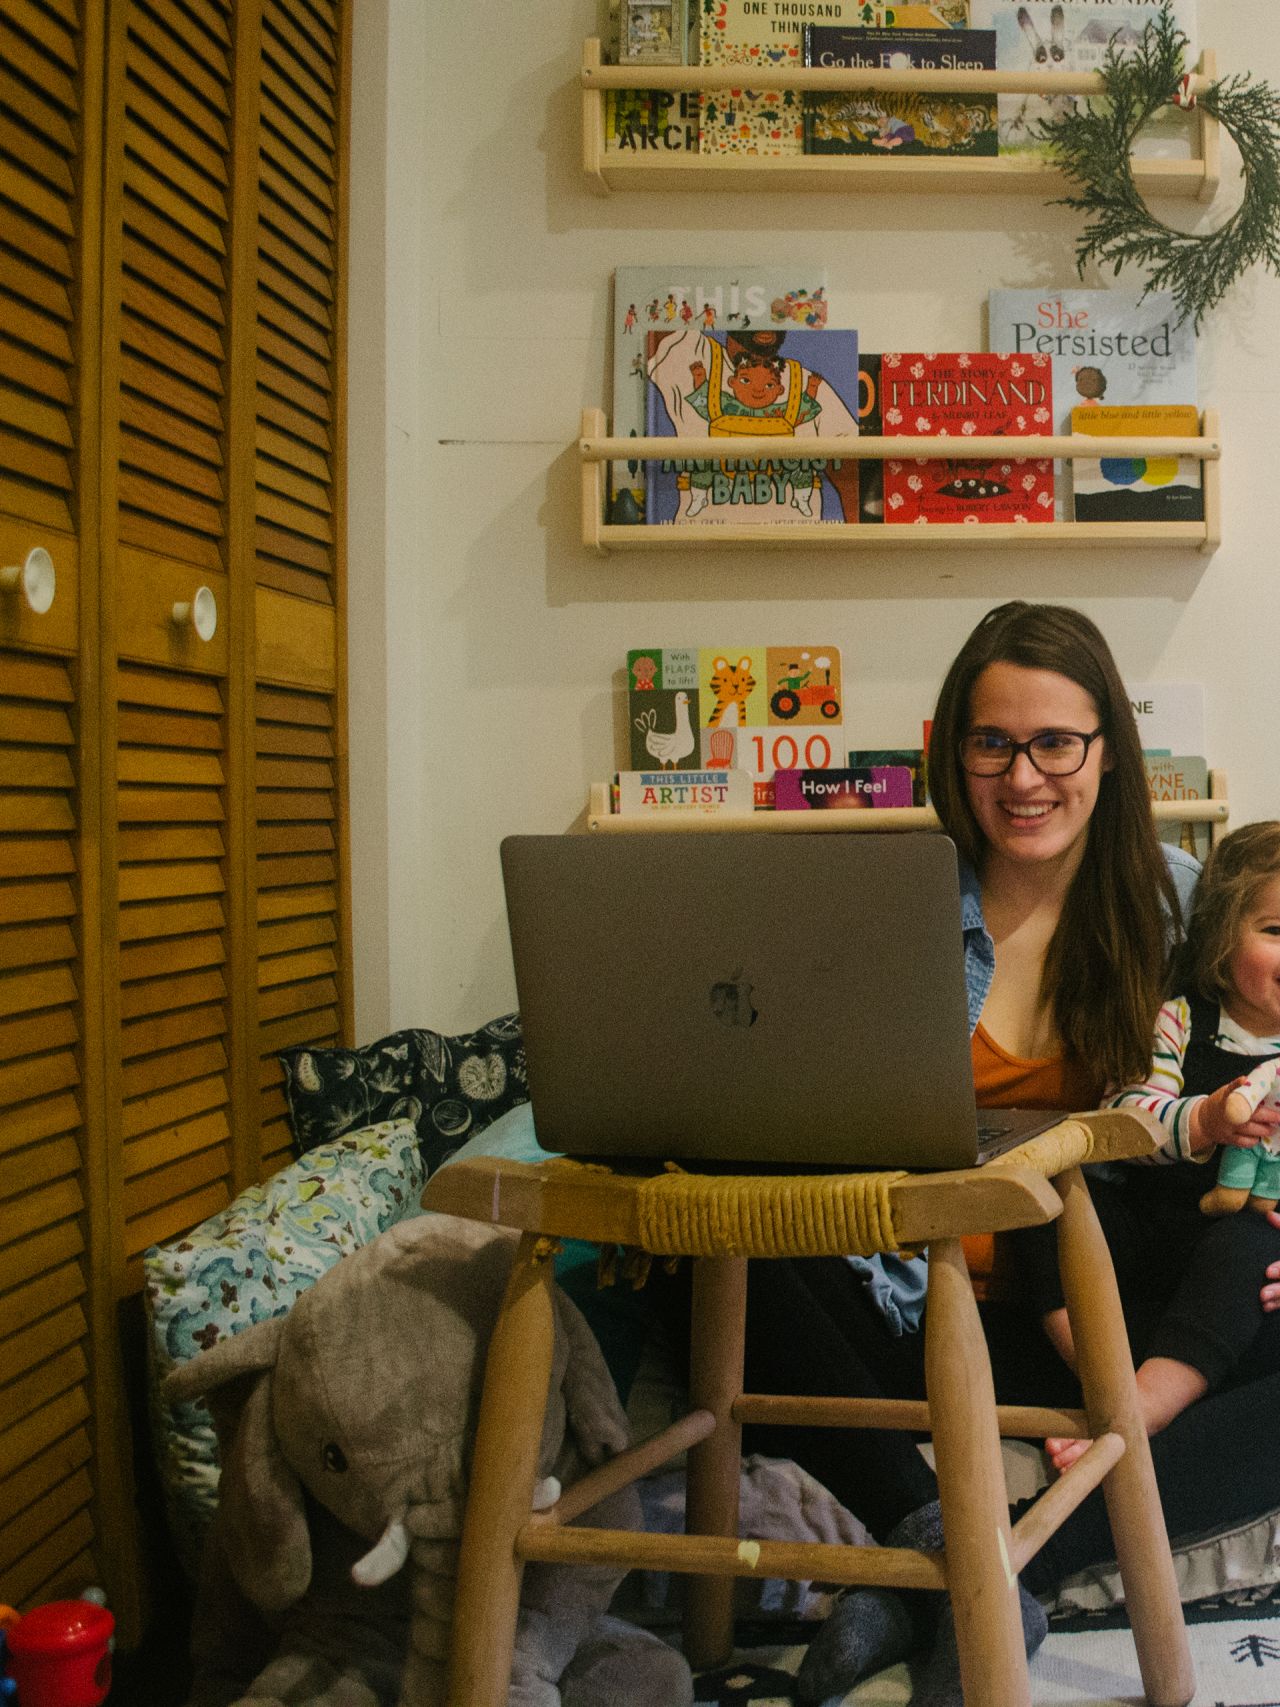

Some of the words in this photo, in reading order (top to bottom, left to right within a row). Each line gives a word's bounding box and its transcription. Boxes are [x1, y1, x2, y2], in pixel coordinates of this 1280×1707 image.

[743, 2, 771, 15] ONE
[775, 2, 842, 18] THOUSAND
[771, 20, 816, 34] THIN
[820, 51, 846, 69] Go
[851, 53, 874, 69] the
[880, 53, 915, 69] Fk
[921, 57, 936, 69] to
[941, 54, 984, 70] Sleep
[669, 286, 767, 318] THIS
[1037, 300, 1089, 329] She
[1011, 321, 1173, 357] Persisted
[892, 380, 1046, 407] FERDINAND
[711, 473, 792, 505] BABY
[670, 653, 691, 661] With
[665, 664, 696, 674] FLAPS
[668, 678, 677, 686] to
[751, 734, 831, 773] 100
[649, 775, 675, 784] THIS
[680, 774, 719, 783] LITTLE
[801, 780, 840, 795] How
[845, 780, 850, 794] I
[855, 779, 887, 793] Feel
[641, 786, 729, 804] ARTIST
[753, 787, 775, 800] irs
